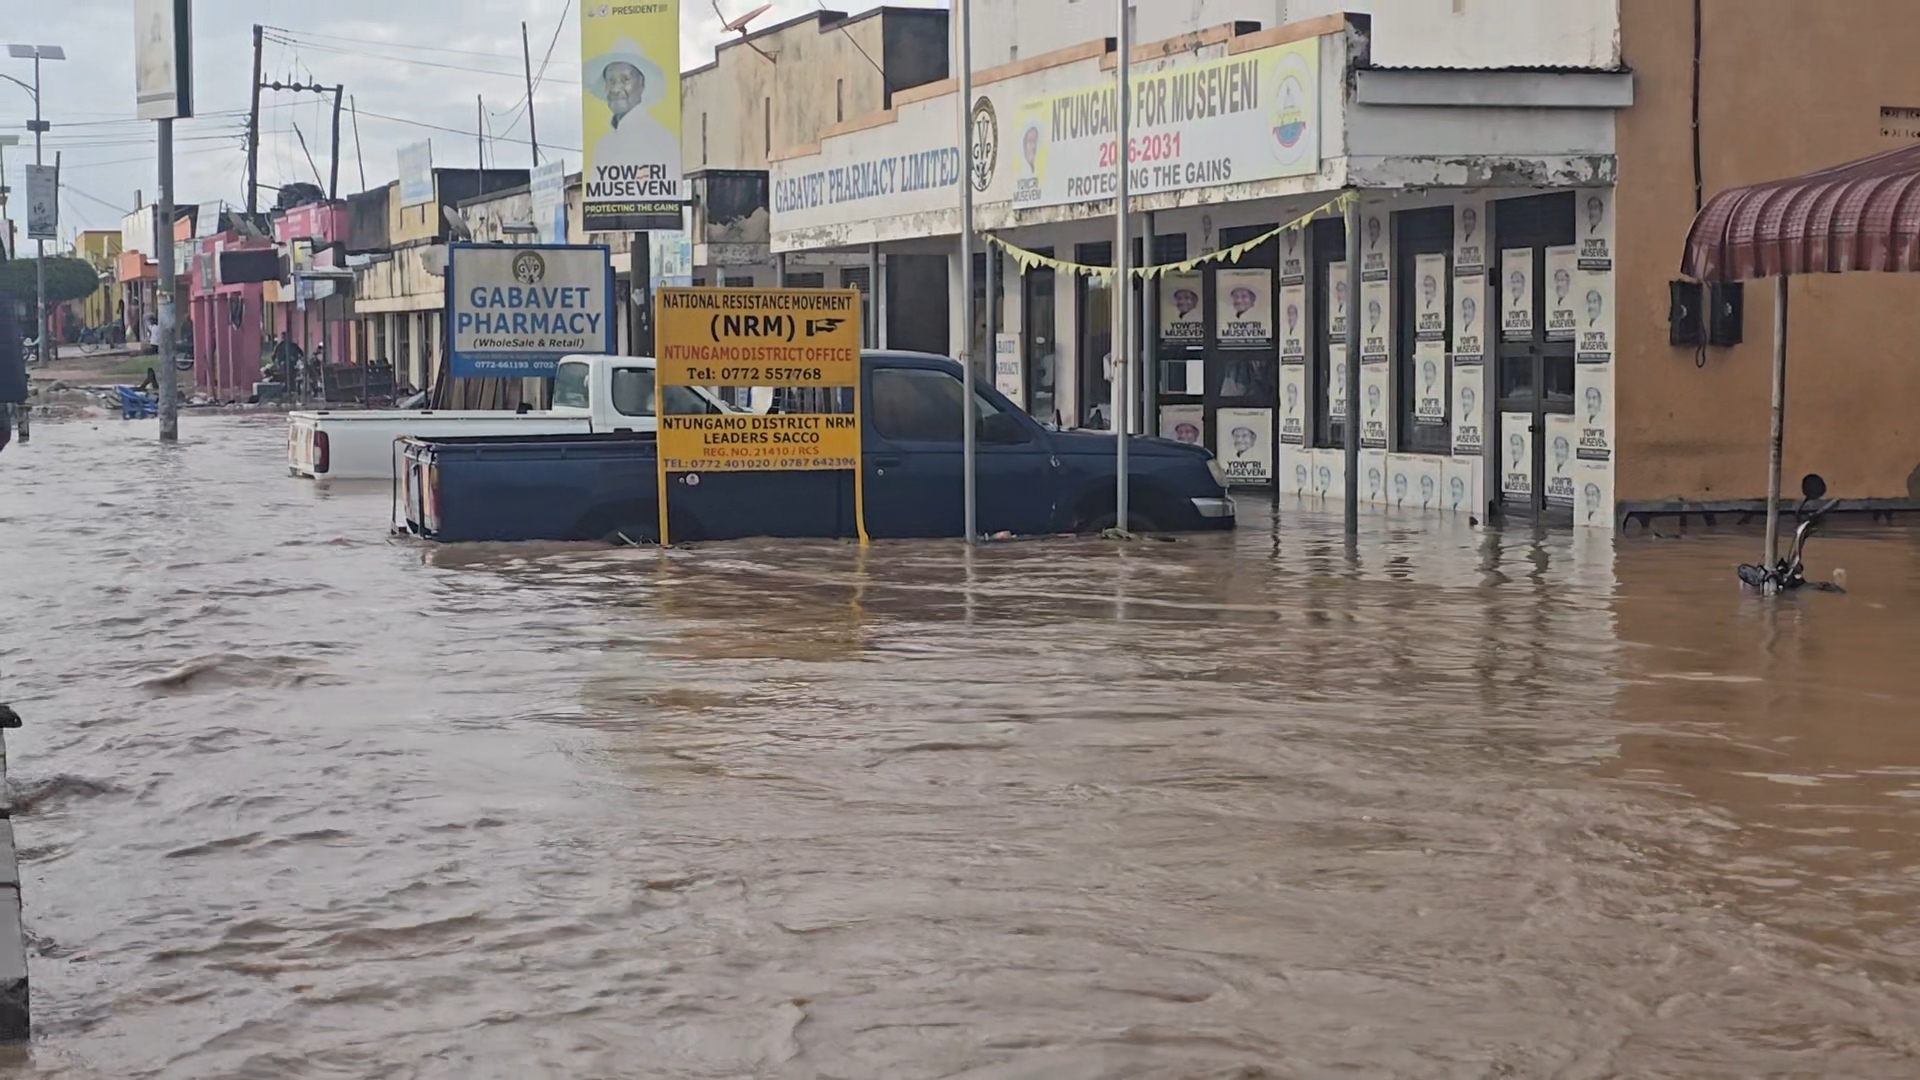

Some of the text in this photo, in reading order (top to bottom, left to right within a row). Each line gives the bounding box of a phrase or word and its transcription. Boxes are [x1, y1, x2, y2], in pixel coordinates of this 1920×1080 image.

[612, 4, 658, 15] PRESIDENT
[1137, 78, 1166, 128] FOR
[1172, 59, 1258, 122] MUSEVENI
[1099, 131, 1180, 167] 206-2031
[774, 147, 960, 213] GABAVET PHARMACY LIMITED
[1068, 157, 1231, 197] PROTECNG THE GAINS
[586, 180, 677, 197] MUSEVENI
[585, 203, 679, 214] PROTECTING THE GAINS
[470, 286, 591, 309] GABAVET
[663, 294, 852, 310] NATIONAL RESISTANCE MOVEMENT
[458, 312, 601, 334] PHARMACY
[711, 314, 795, 342] (NRM)
[1221, 329, 1266, 337] MUSEVENI
[537, 339, 546, 347] &
[549, 338, 585, 349] Retail)
[664, 345, 852, 361] NTUNGAMO DISTRICT OFFICE
[533, 361, 559, 369] 0702-
[687, 367, 822, 380] Tel: 0772 557768
[663, 417, 856, 430] NTUNGAMO DISTRICT NRM
[704, 432, 820, 444] LEADERS SACCO
[754, 447, 789, 456] 21410
[798, 446, 820, 455] RCS
[663, 458, 688, 468] TEL:
[691, 458, 721, 468] 0772
[724, 458, 771, 468] 401020
[781, 458, 810, 467] 0787
[813, 457, 856, 467] 642396
